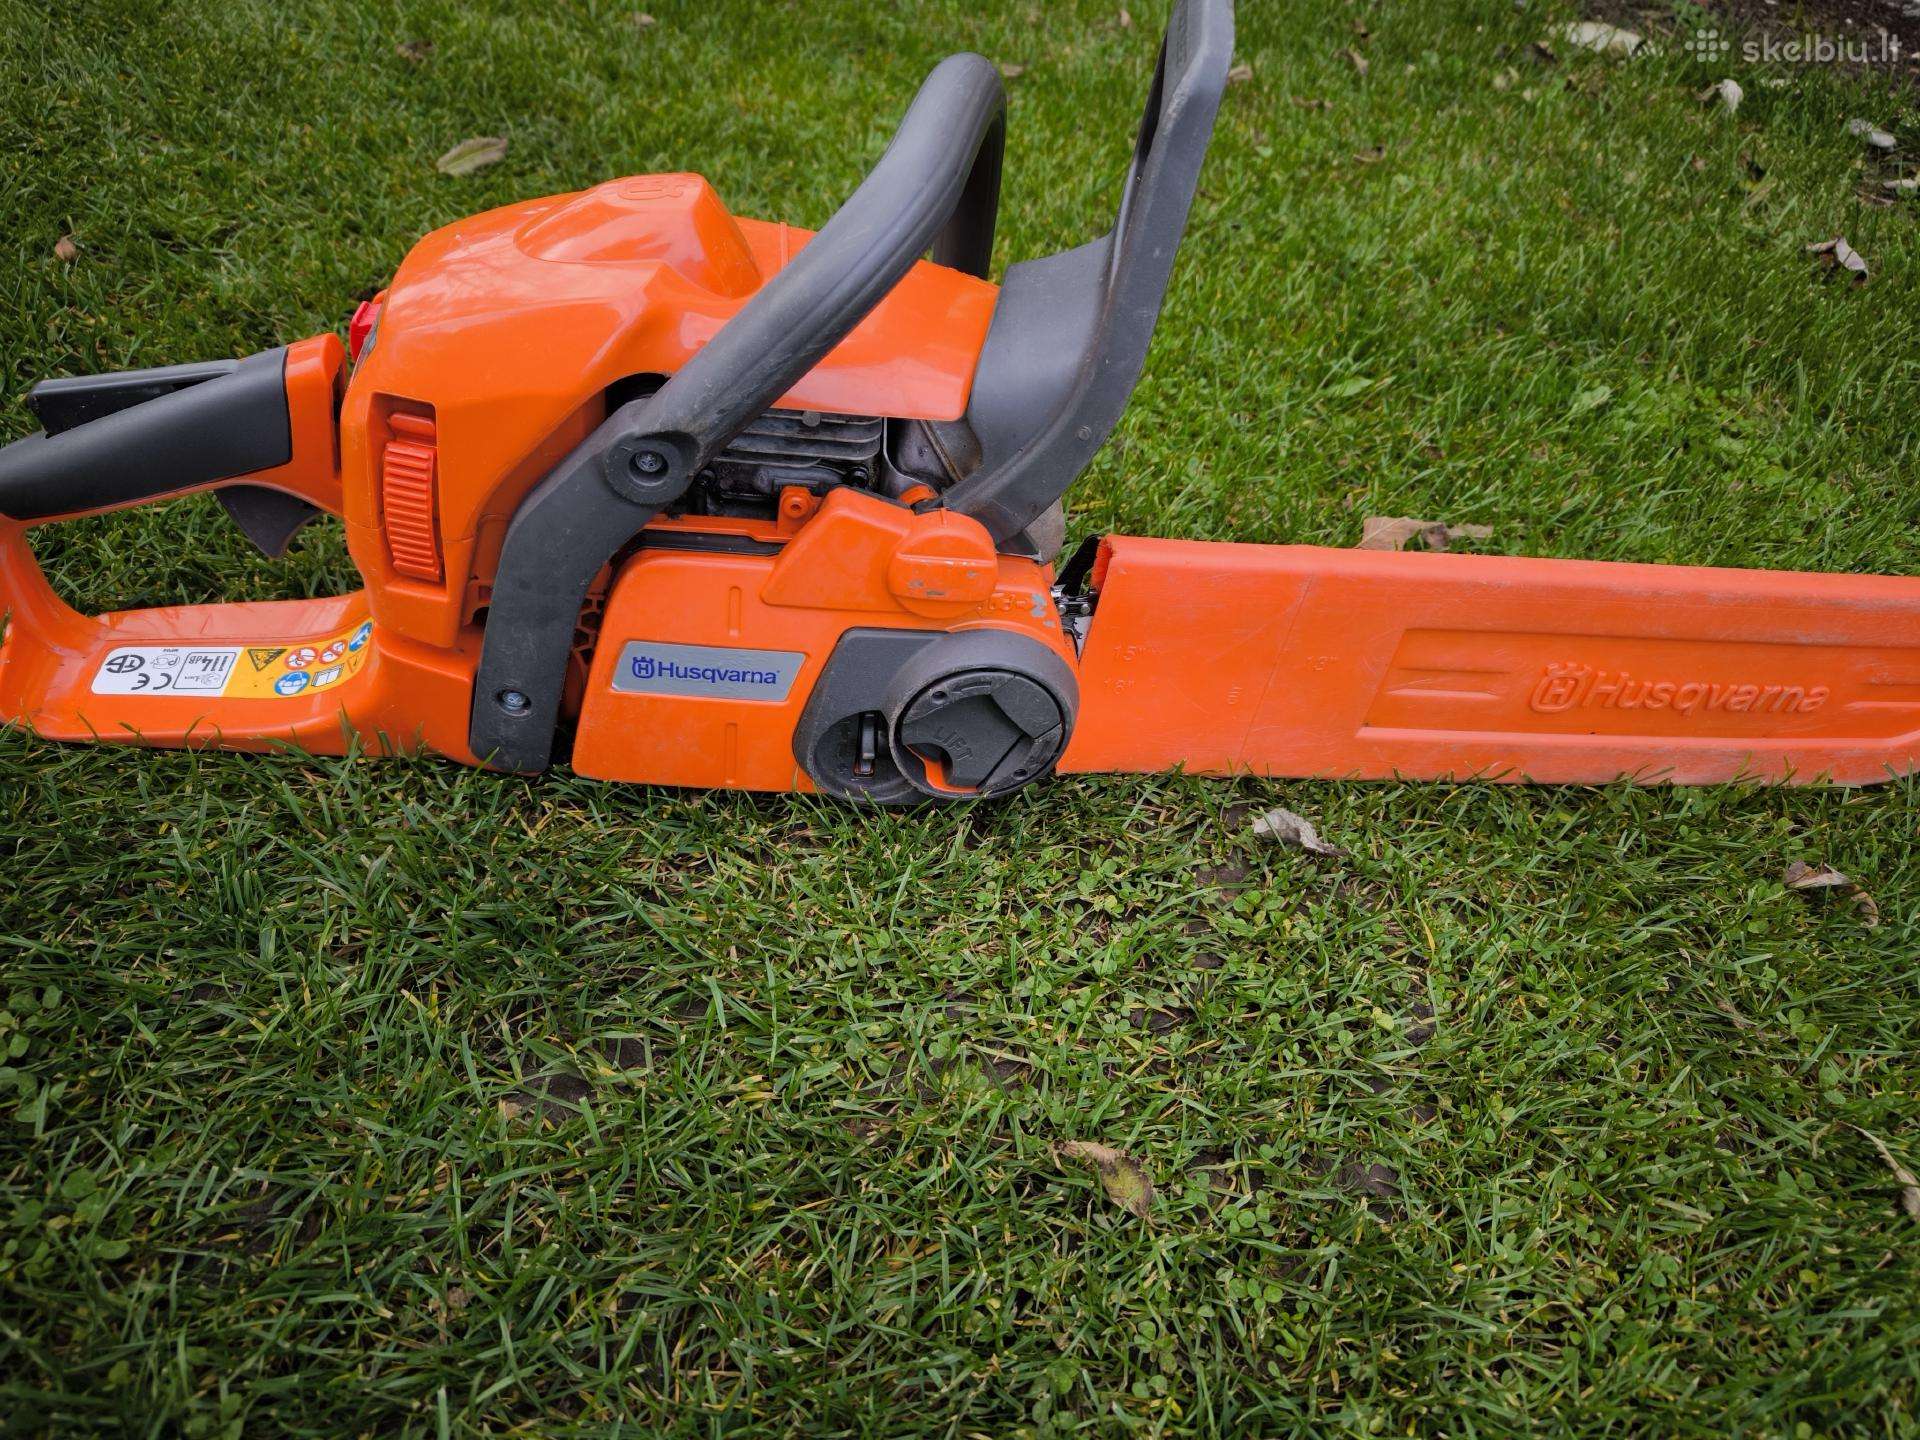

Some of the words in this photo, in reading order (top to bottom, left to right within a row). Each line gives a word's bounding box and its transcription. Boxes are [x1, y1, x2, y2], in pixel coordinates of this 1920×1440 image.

[202, 656, 229, 672] 114
[658, 661, 778, 684] Husqvarna
[1582, 670, 1830, 718] Husqvarna
